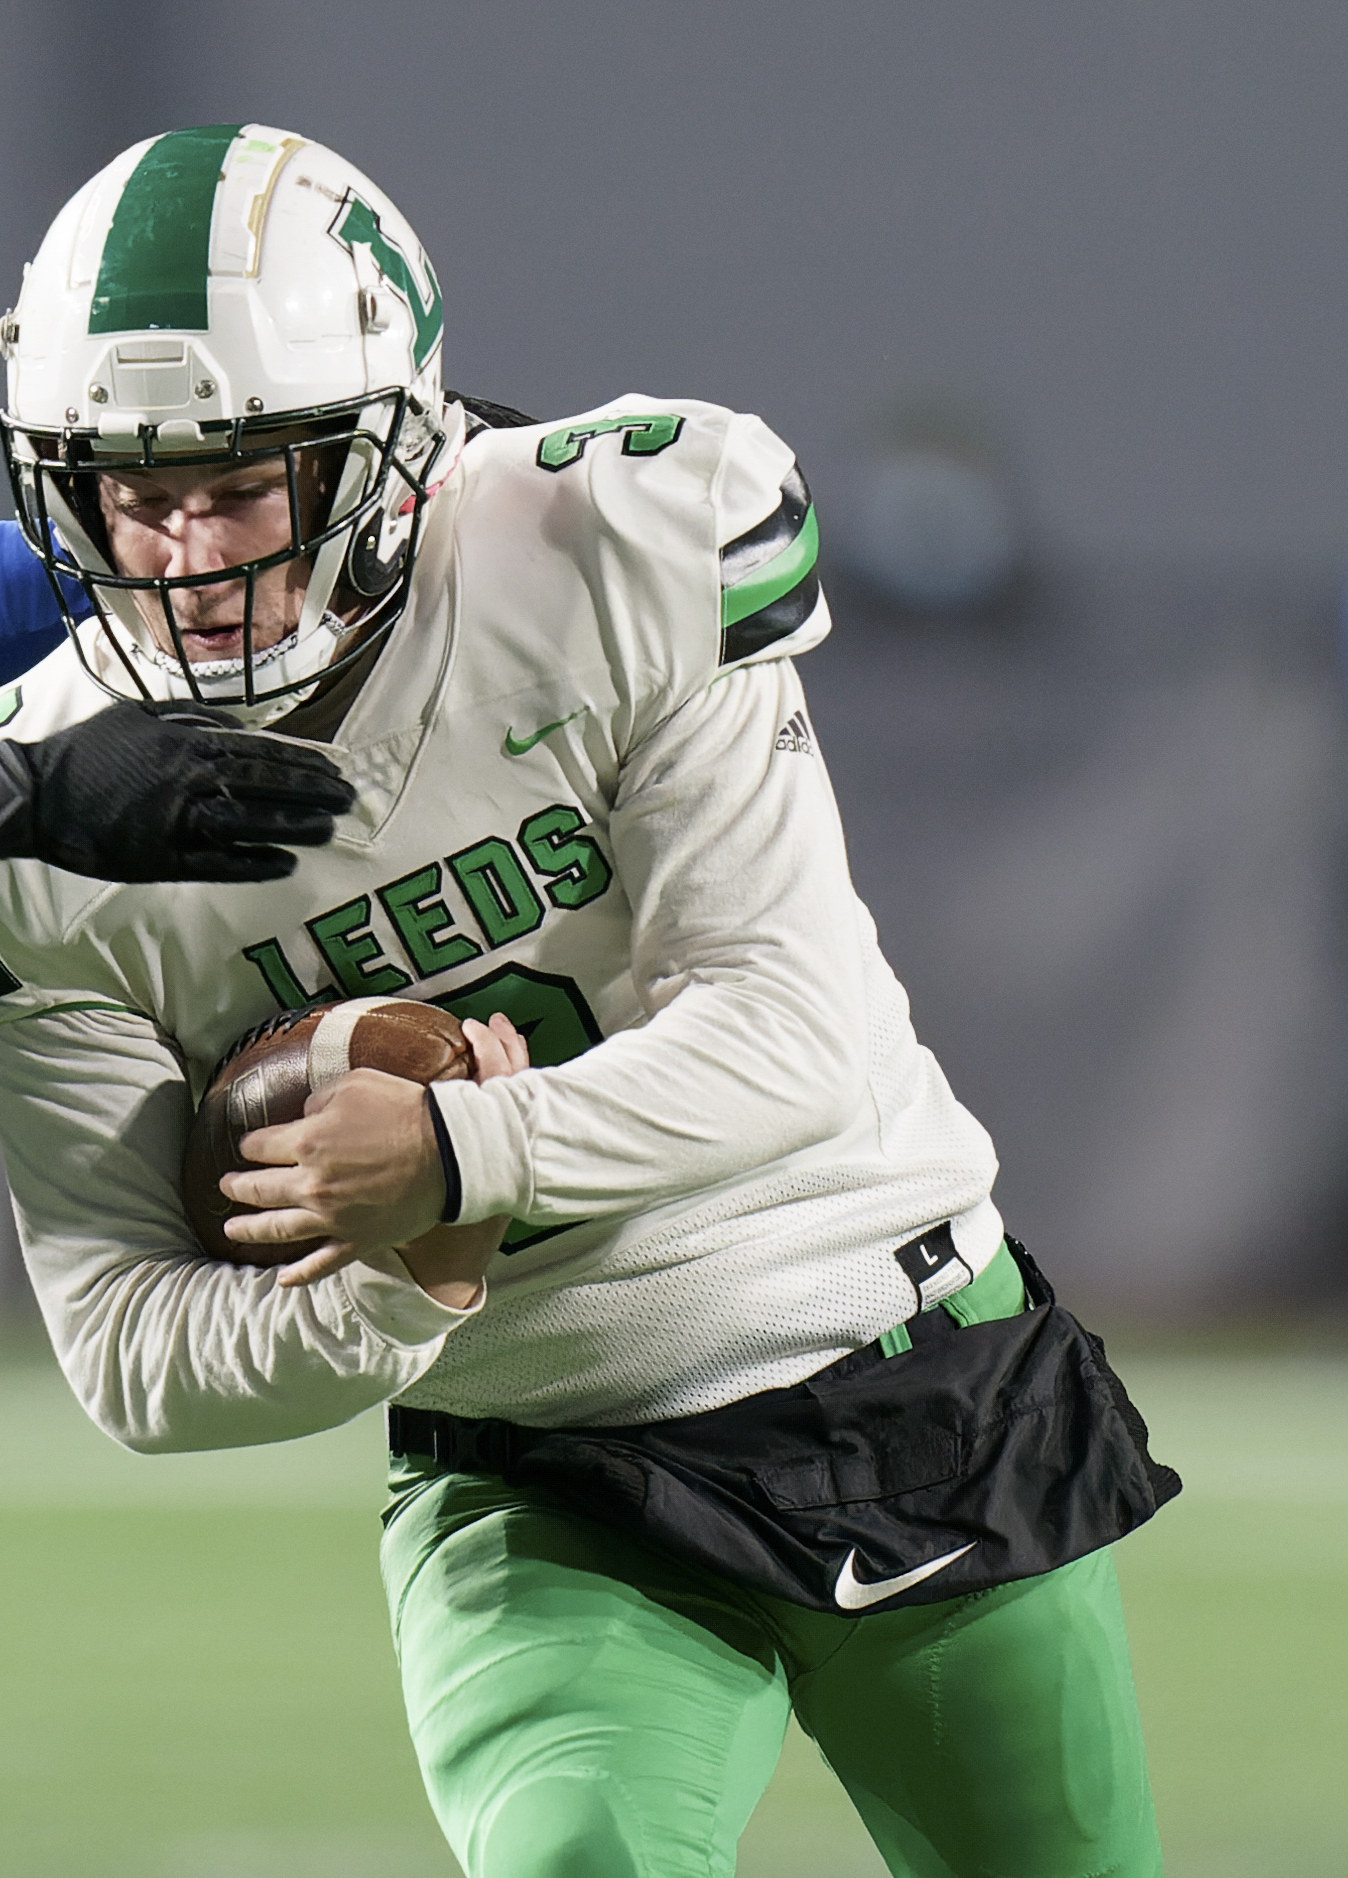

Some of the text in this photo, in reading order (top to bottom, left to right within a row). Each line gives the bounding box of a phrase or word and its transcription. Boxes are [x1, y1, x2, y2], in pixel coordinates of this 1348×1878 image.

[536, 413, 686, 473] 3
[242, 803, 613, 1010] LEEDS
[919, 1244, 939, 1266] L
